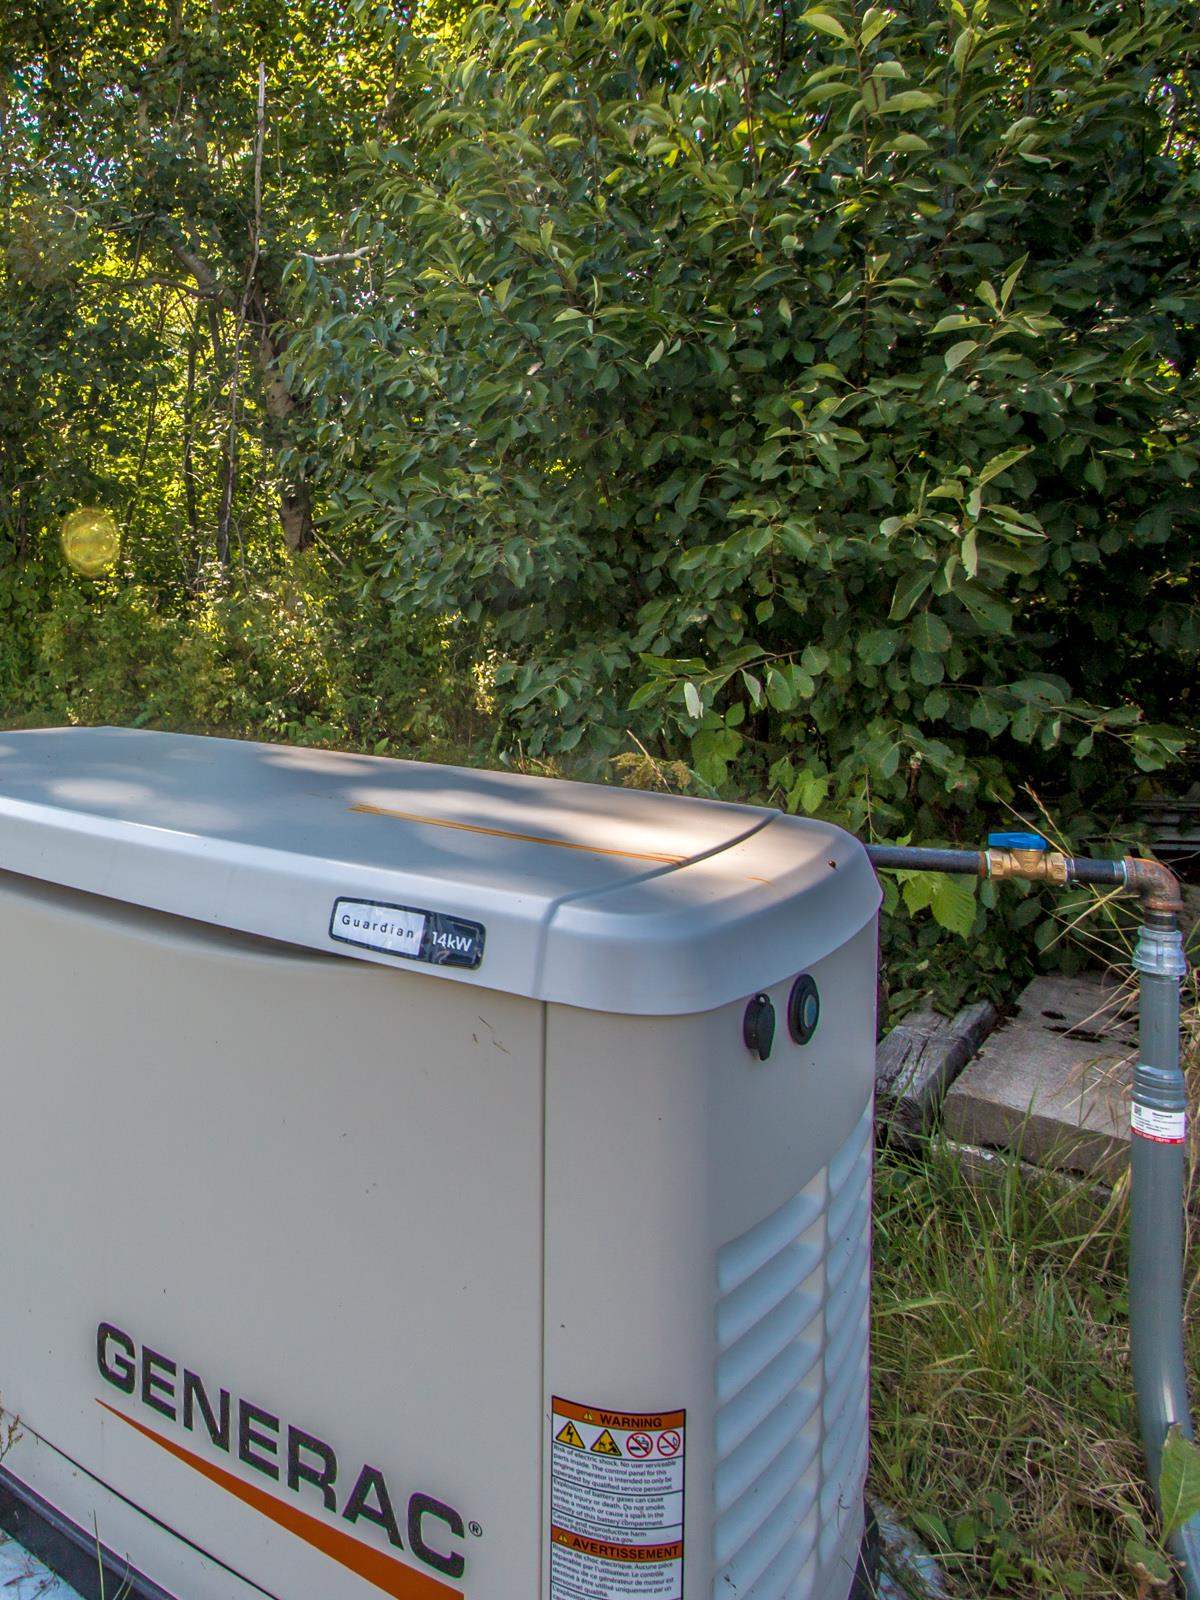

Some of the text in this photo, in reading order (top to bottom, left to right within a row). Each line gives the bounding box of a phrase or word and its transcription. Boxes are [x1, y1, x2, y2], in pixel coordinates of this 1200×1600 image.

[341, 914, 472, 952] Guardian 14kW
[600, 1414, 662, 1428] WARNING
[97, 1321, 465, 1579] GENERAC
[592, 1464, 603, 1472] The
[576, 1469, 607, 1480] generator
[592, 1481, 619, 1490] qualified
[592, 1490, 615, 1501] battery
[576, 1503, 596, 1512] match
[597, 1515, 619, 1525] battery
[589, 1525, 629, 1536] reproductive
[572, 1538, 678, 1559] AVERTISSEMENT
